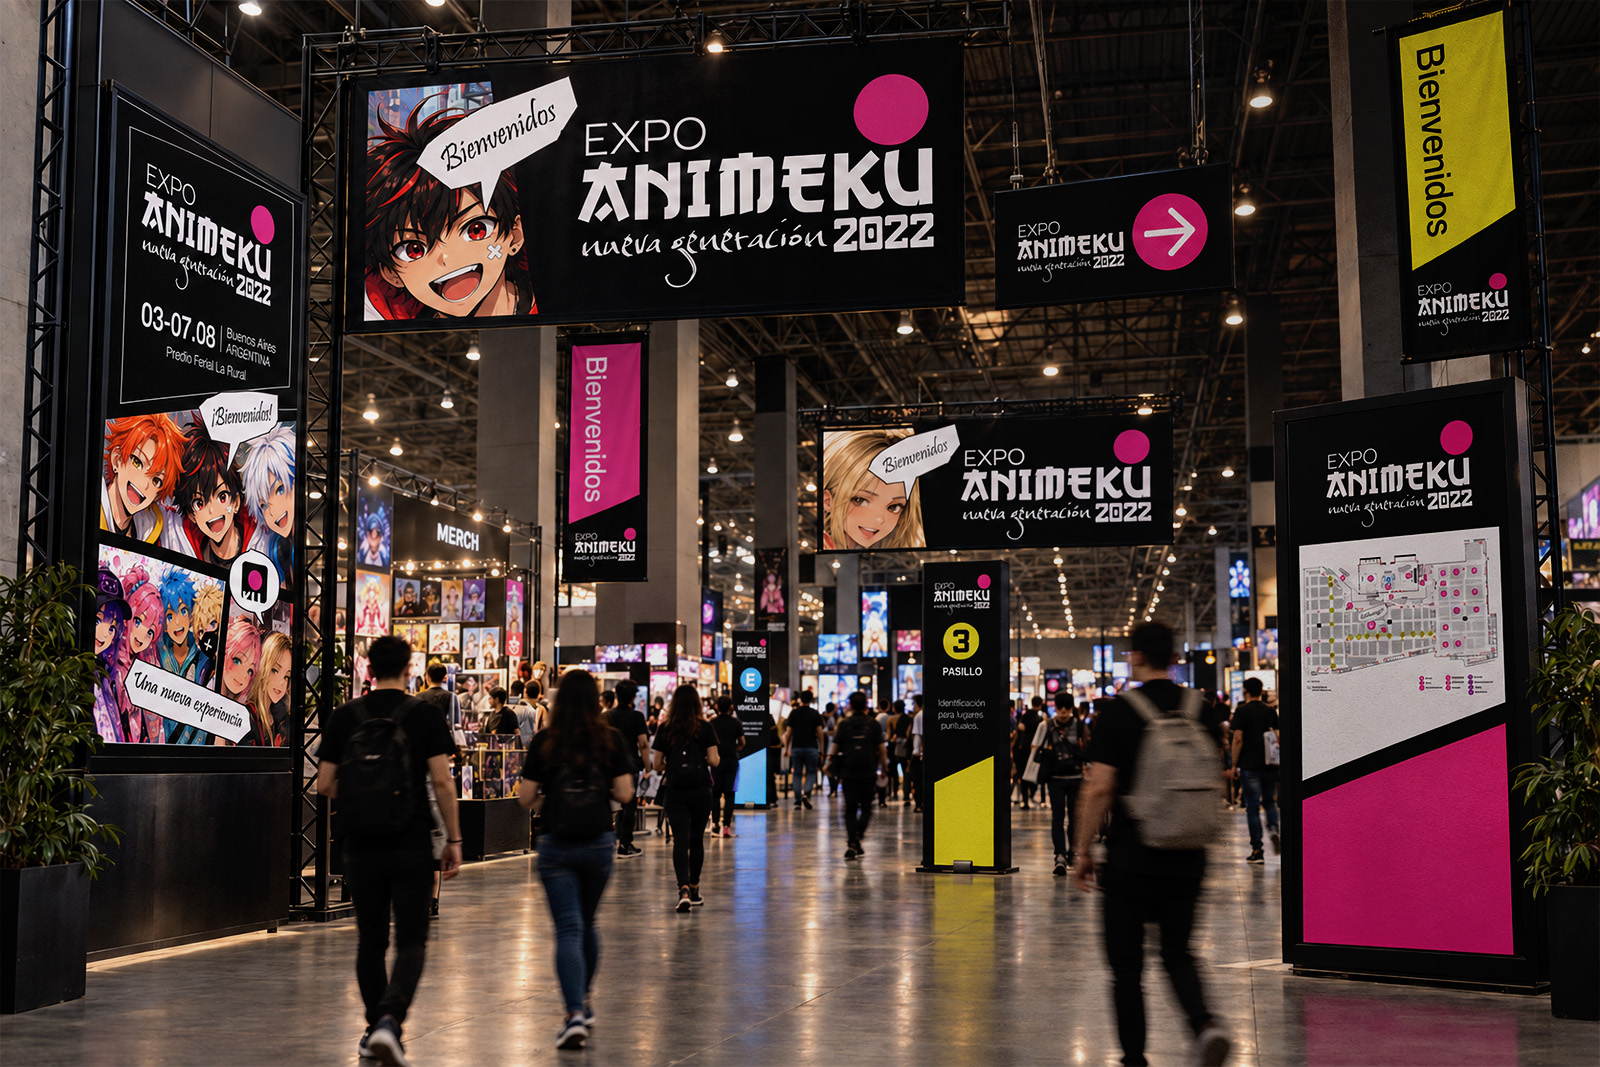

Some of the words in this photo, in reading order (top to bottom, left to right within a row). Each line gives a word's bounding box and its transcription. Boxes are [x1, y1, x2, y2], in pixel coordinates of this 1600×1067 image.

[440, 97, 557, 172] Bienvenidos
[584, 117, 706, 156] EXPO
[1416, 44, 1454, 238] Bienvenidos
[146, 163, 196, 205] EXPO
[577, 148, 934, 223] ANIMEKU
[141, 191, 271, 281] ANIMEKU
[1018, 221, 1060, 238] EXPO
[581, 229, 661, 257] nueva
[664, 218, 827, 288] generación
[833, 213, 935, 253] 2022
[1017, 232, 1124, 260] ANIMEKU
[142, 240, 177, 263] nueva
[176, 256, 234, 290] generación
[236, 275, 272, 306] 2022
[1093, 254, 1125, 269] 2022
[1417, 282, 1452, 296] EXPO
[1418, 290, 1508, 316] ANIMEKU
[142, 302, 215, 348] 03-07.08
[1481, 309, 1509, 322] 2022
[226, 327, 256, 347] Buenos
[257, 338, 277, 354] Aires
[166, 346, 192, 364] Predio
[194, 354, 214, 371] Ferial
[215, 361, 225, 375] La
[227, 365, 247, 380] Rural
[226, 344, 271, 367] ARGENTINA
[211, 401, 272, 427] ¡Bienvenidos!
[584, 357, 607, 503] Bienvenidos
[882, 439, 949, 474] Bienvenidos
[964, 448, 1025, 467] EXPO
[1327, 448, 1378, 470] EXPO
[961, 466, 1151, 501] ANIMEKU
[1326, 457, 1470, 498] ANIMEKU
[963, 506, 1006, 521] nueva
[1006, 502, 1092, 540] generación
[1095, 502, 1152, 523] 2022
[1328, 502, 1361, 515] nueva
[1361, 494, 1425, 528] generación
[1427, 489, 1473, 510] 2022
[437, 523, 479, 551] MERCH
[574, 540, 636, 554] ANIMEKU
[575, 532, 598, 541] EXPO
[934, 589, 990, 602] ANIMEKU
[952, 629, 970, 653] 3
[746, 673, 755, 687] E
[942, 667, 982, 676] PASILLO
[134, 671, 158, 695] Una
[160, 686, 192, 708] nueva
[193, 699, 243, 728] experiencia
[938, 712, 954, 720] para
[957, 710, 984, 720] lugares
